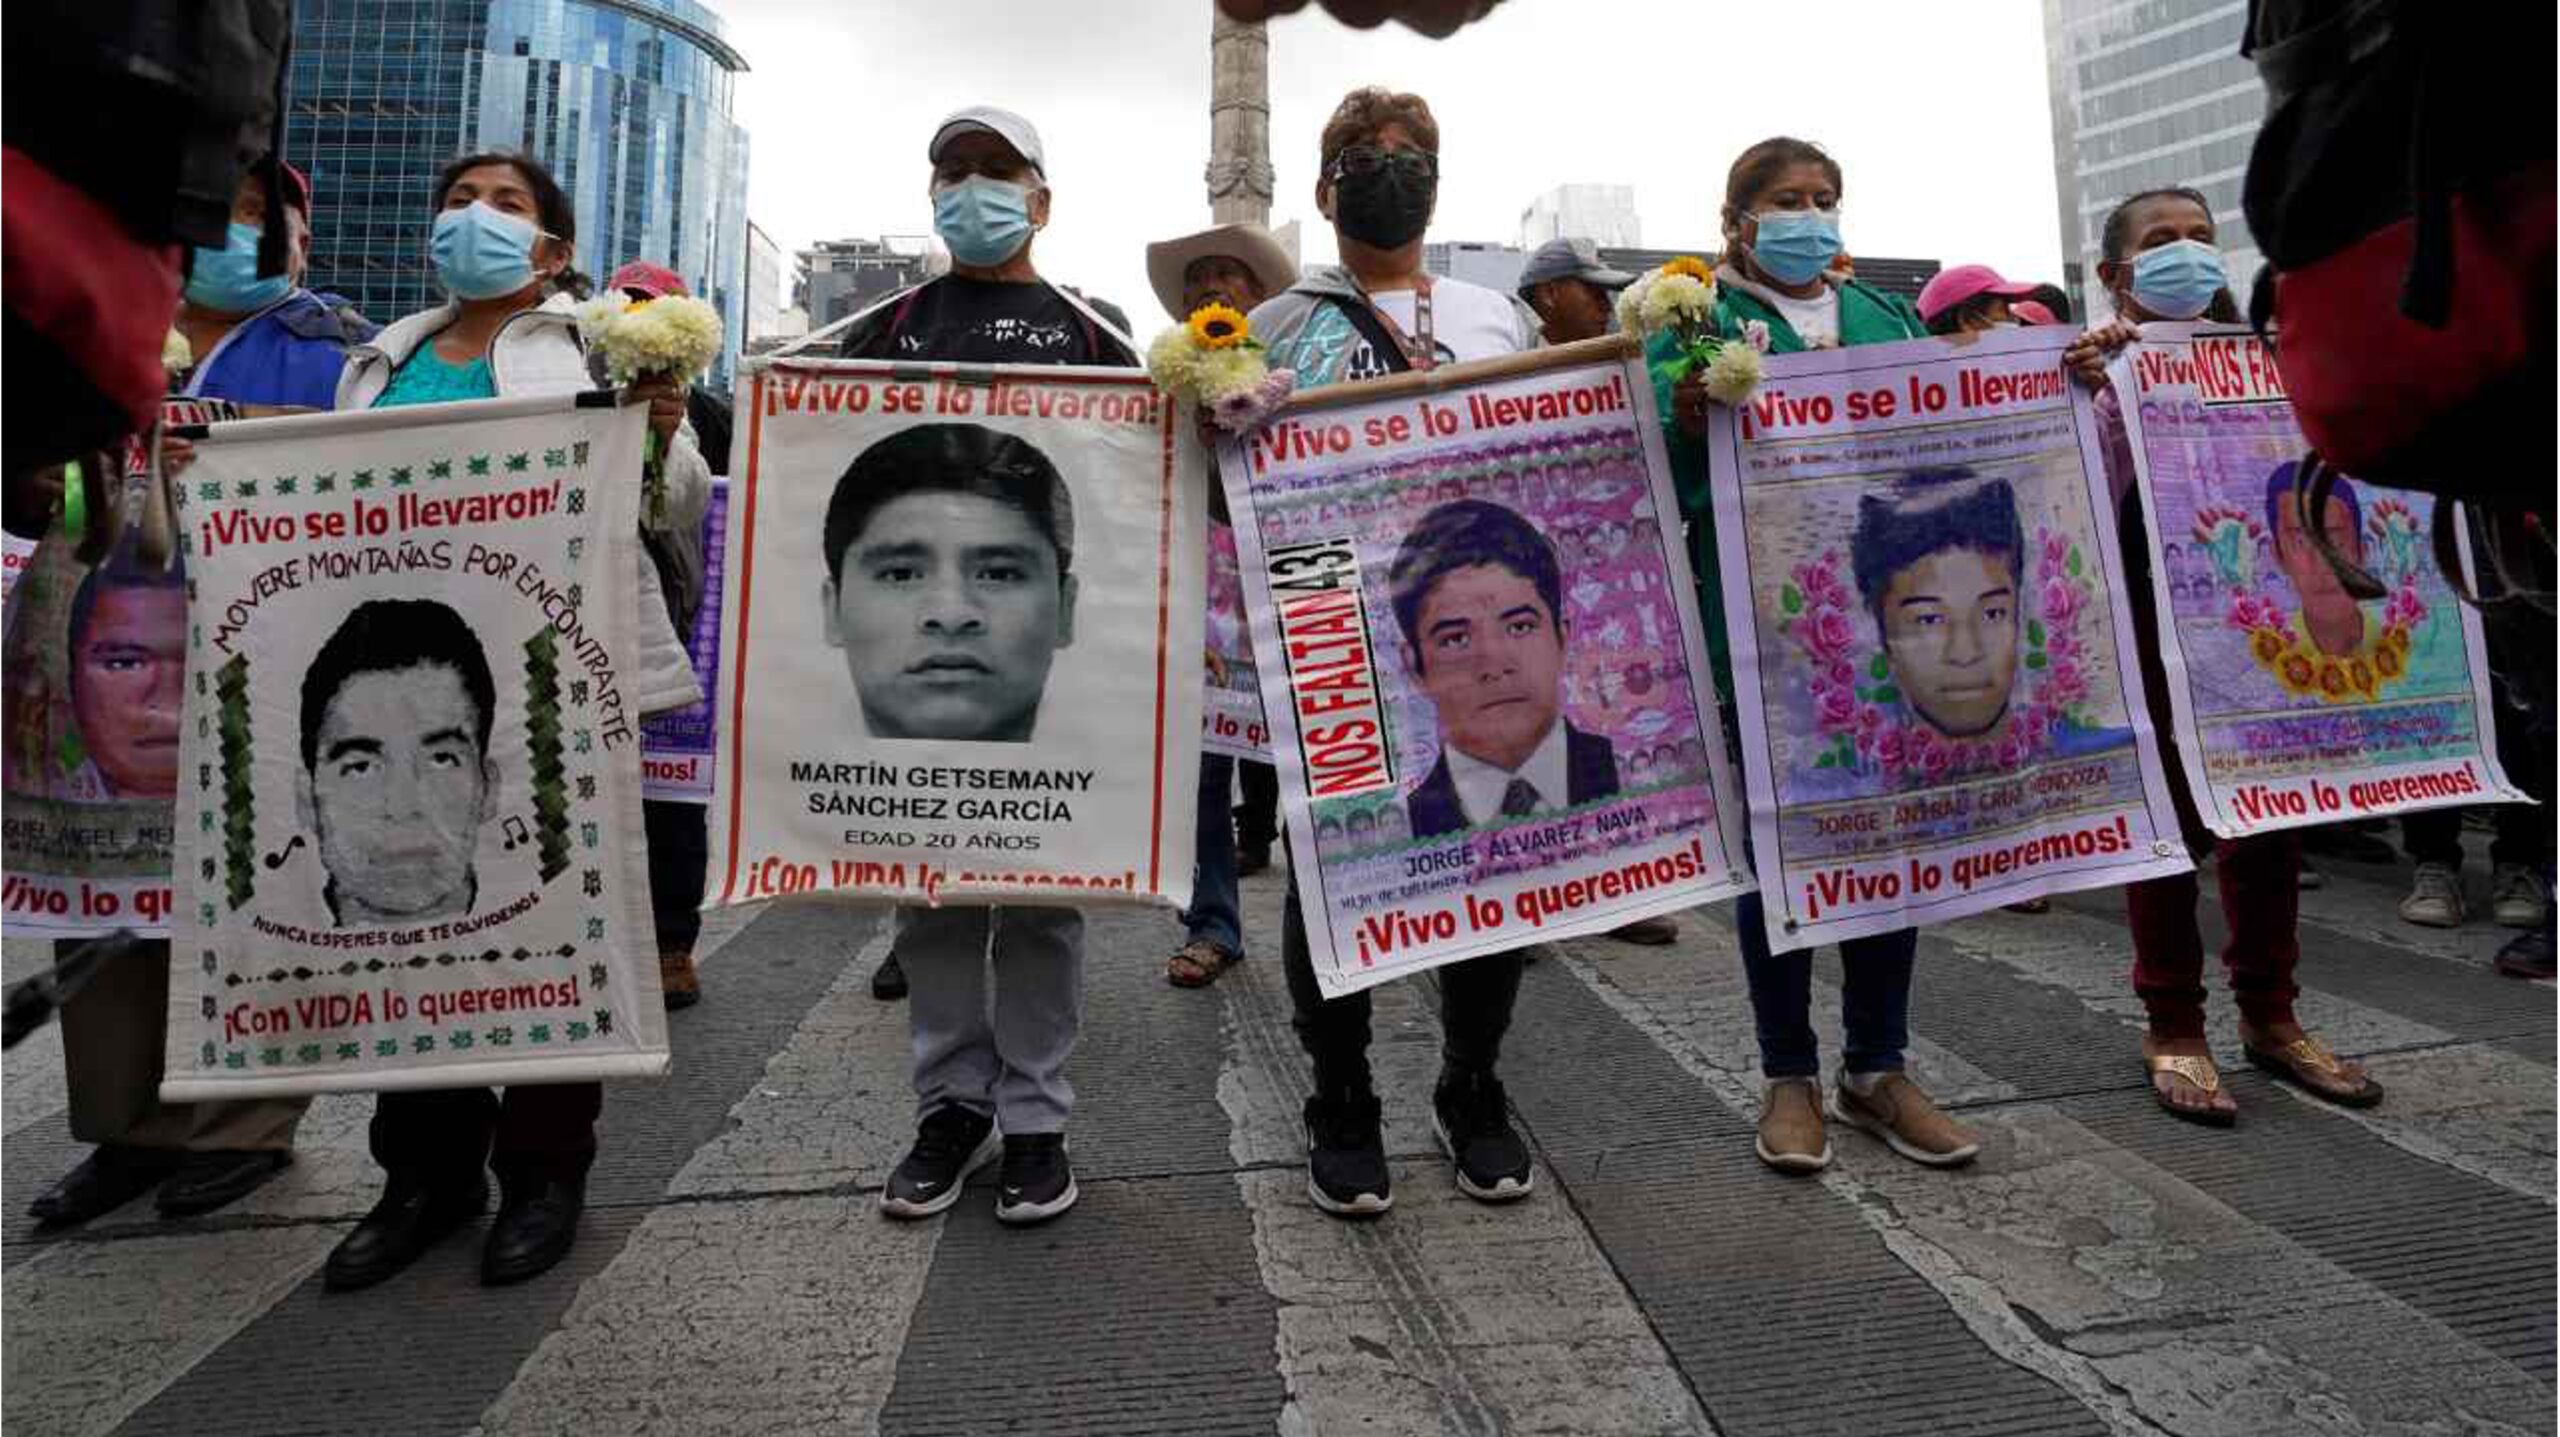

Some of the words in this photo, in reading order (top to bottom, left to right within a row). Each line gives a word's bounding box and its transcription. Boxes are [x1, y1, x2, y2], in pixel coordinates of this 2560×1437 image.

[766, 373, 869, 417] ¡Vivo
[881, 384, 923, 414] se
[937, 378, 973, 415] lo
[986, 381, 1159, 424] llevaron!
[2192, 338, 2244, 398] NOS
[1250, 415, 1351, 474] ¡Vivo
[1363, 413, 1412, 448] se
[1419, 401, 1459, 438] lo
[1467, 374, 1629, 431] llevaron!
[1739, 391, 1834, 440] ¡Vivo
[1847, 390, 1897, 421] se
[1909, 375, 1947, 415] lo
[1960, 366, 2066, 407] llevaron!
[200, 508, 296, 558] ¡Vivo
[304, 513, 346, 540] se
[354, 498, 389, 537] lo
[399, 480, 561, 531] llevaron!
[1267, 538, 1355, 590] 43!
[307, 540, 452, 582] MONTAÑAS
[463, 543, 519, 581] POR
[514, 563, 633, 751] ENCONTRARTE
[1279, 588, 1374, 716] FALTAN
[790, 760, 898, 786] MARTÍN
[906, 765, 1095, 792] GETSEMANY
[1304, 719, 1387, 796] NOS
[808, 791, 947, 820] SÁNCHEZ
[957, 796, 1073, 822] GARCÍA
[1812, 811, 1880, 838] JORGE
[2232, 783, 2307, 828] ¡Vivo
[2311, 778, 2342, 813] lo
[2349, 760, 2482, 811] queremos!
[844, 829, 915, 847] EDAD
[924, 832, 956, 849] 20
[965, 830, 1041, 851] AÑOS
[1405, 844, 1476, 878] JORGE
[1596, 805, 1648, 835] NAVA
[1806, 865, 1900, 919] ¡Vivo
[1910, 857, 1941, 894] lo
[1952, 815, 2132, 891] queremos!
[81, 882, 120, 917] lo
[253, 914, 308, 945] NUNCA
[390, 928, 425, 947] QUE
[428, 924, 452, 943] TE
[1355, 907, 1456, 968] ¡Vivo
[1468, 893, 1504, 932] lo
[1515, 839, 1707, 928] queremos!
[224, 1003, 290, 1044] ¡Con
[294, 990, 373, 1032] VIDA
[383, 987, 409, 1023] lo
[418, 974, 582, 1025] queremos!
